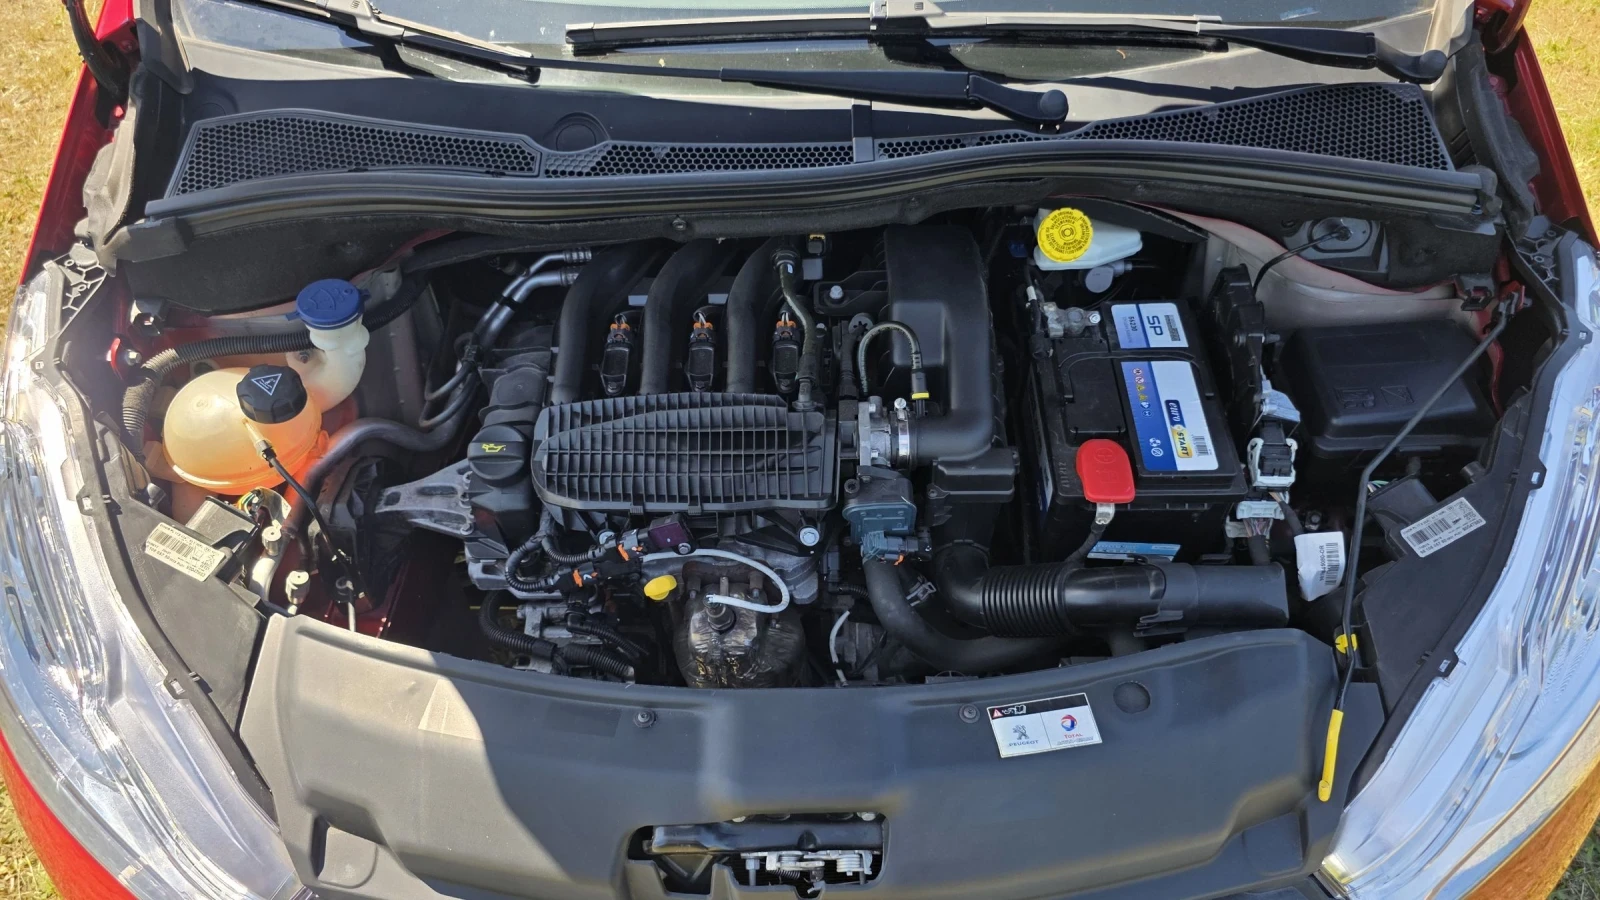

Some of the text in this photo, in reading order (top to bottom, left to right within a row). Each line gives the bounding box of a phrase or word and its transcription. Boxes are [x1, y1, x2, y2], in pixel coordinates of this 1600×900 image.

[1146, 315, 1164, 336] SP
[1169, 402, 1190, 457] euro START
